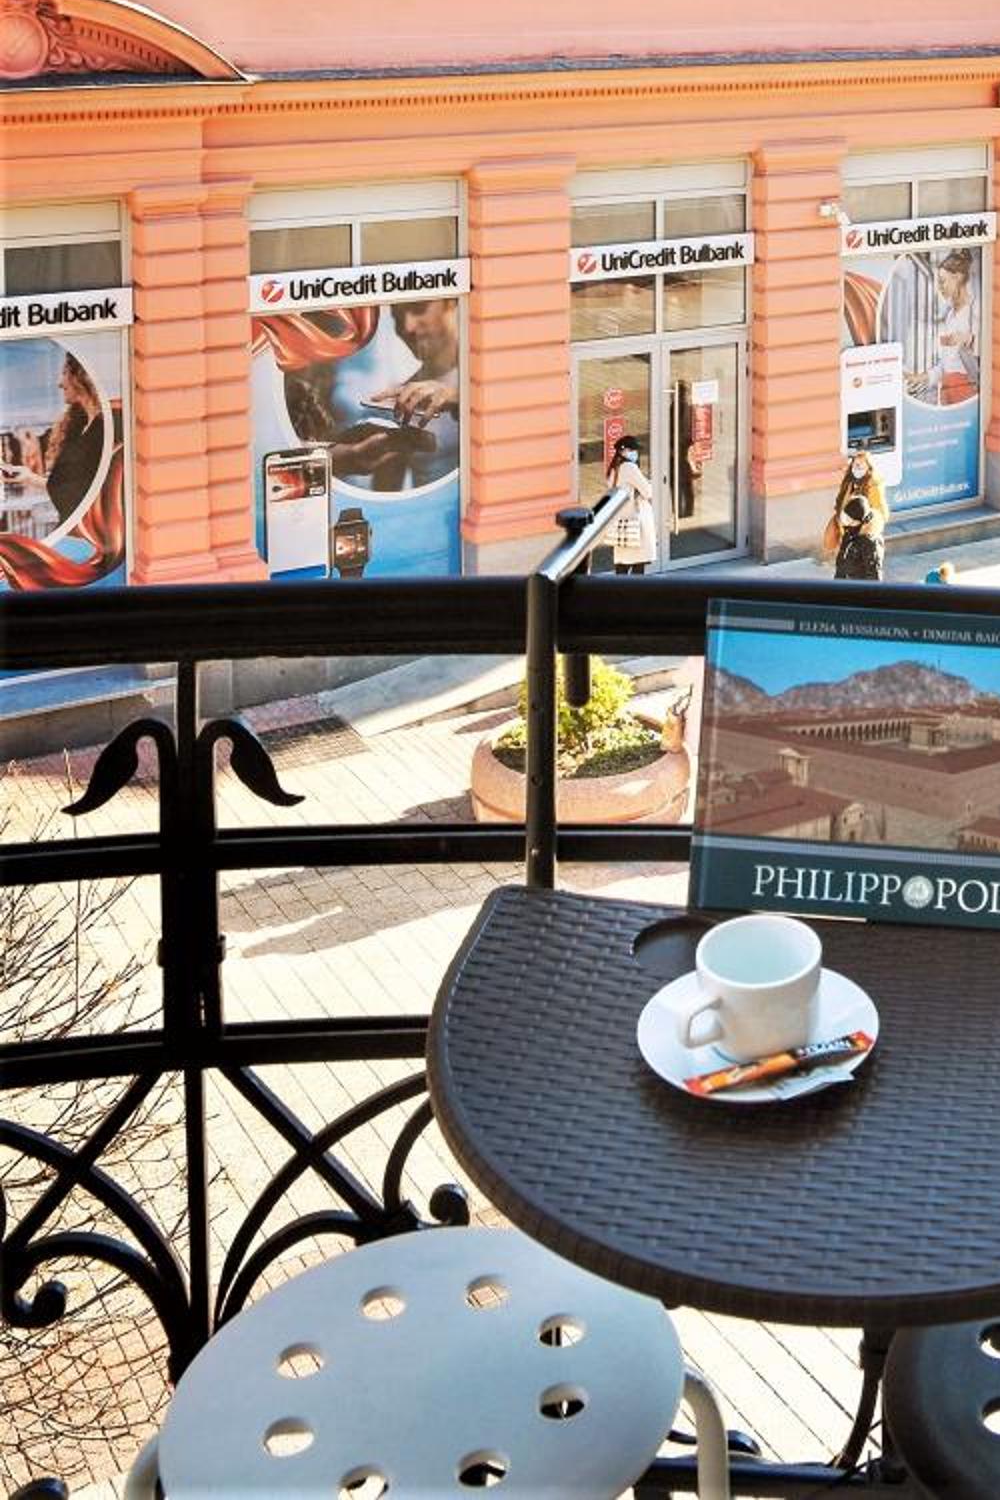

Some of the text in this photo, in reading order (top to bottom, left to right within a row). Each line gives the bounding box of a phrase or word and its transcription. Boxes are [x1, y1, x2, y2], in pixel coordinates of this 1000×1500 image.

[867, 220, 988, 247] UniCredit Bulbank
[601, 241, 744, 271] UniCredit Bulbank
[289, 268, 458, 300] UniCredit Bulbank
[28, 298, 118, 326] Bulbank
[800, 620, 837, 633] ELENA
[922, 628, 973, 642] DIMITAR
